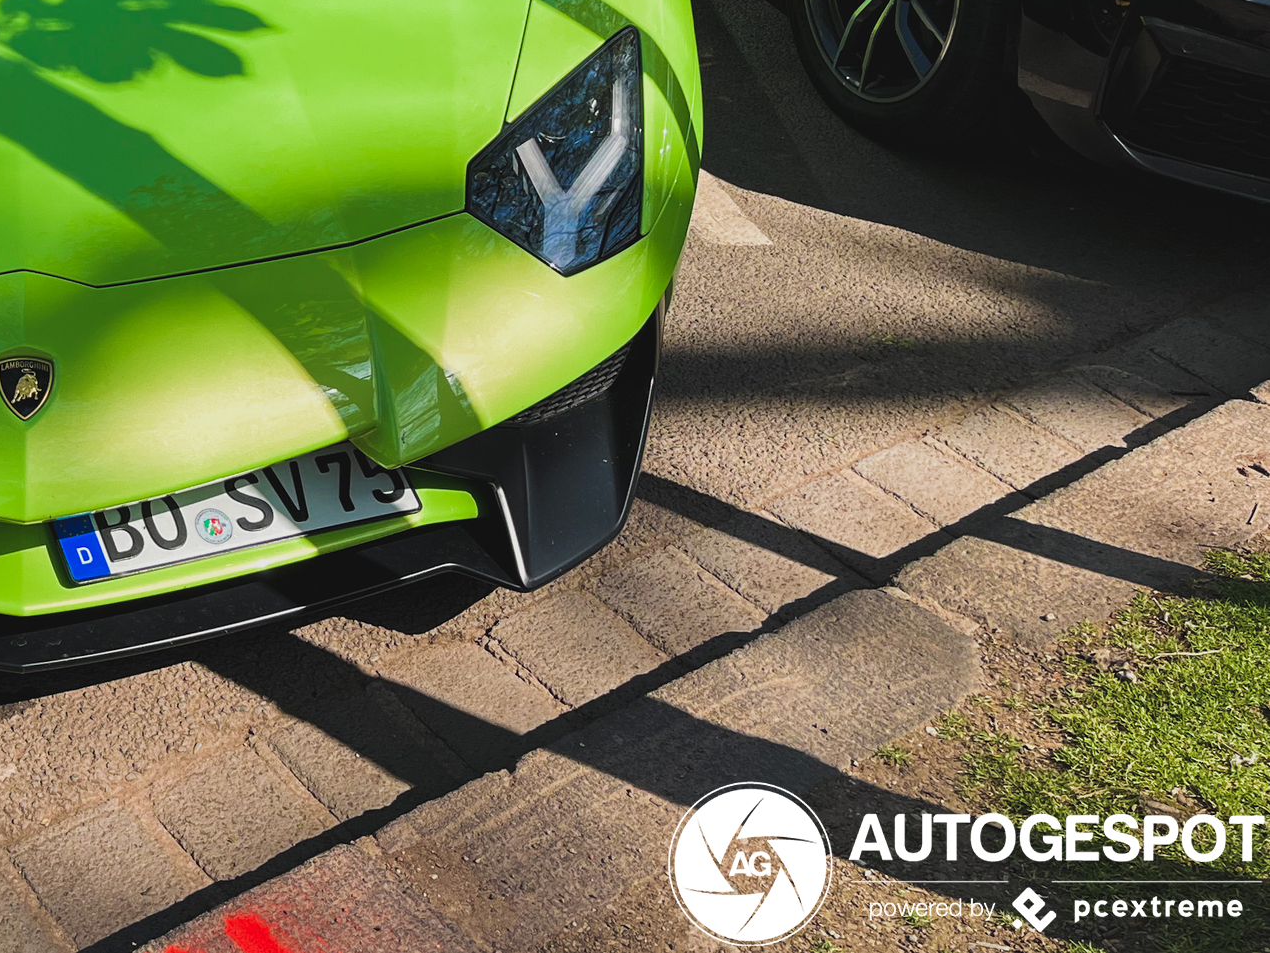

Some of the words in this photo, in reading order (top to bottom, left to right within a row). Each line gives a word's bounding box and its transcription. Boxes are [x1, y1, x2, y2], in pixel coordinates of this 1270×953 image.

[1, 361, 48, 372] LAMBORGHINI
[96, 496, 188, 562] BO
[225, 461, 309, 531] SV
[315, 450, 405, 512] 75
[77, 546, 94, 565] D
